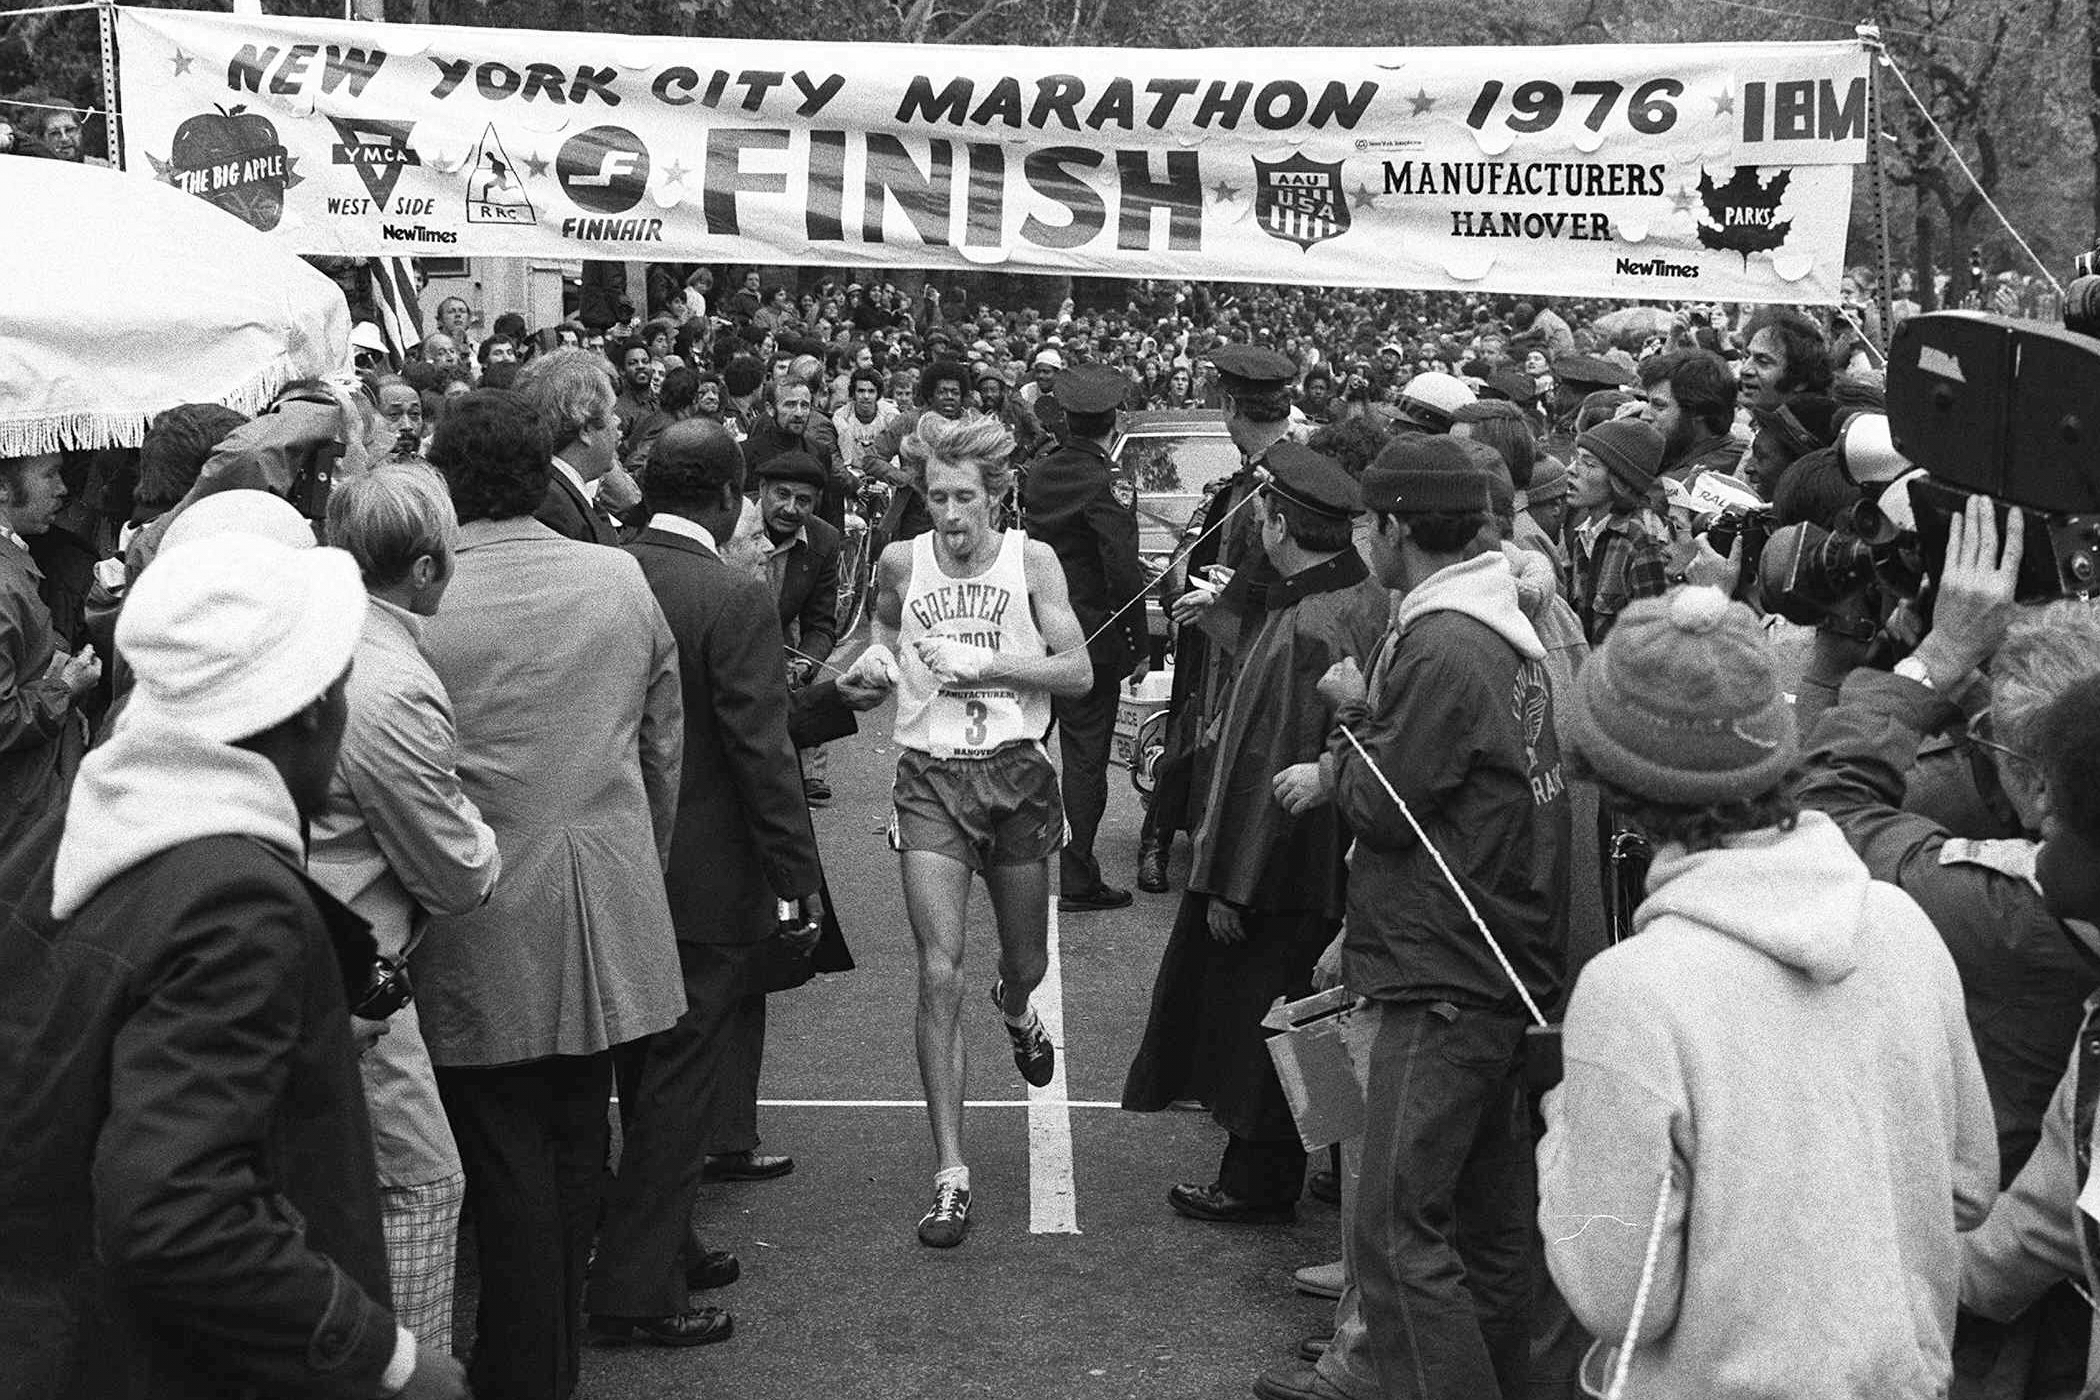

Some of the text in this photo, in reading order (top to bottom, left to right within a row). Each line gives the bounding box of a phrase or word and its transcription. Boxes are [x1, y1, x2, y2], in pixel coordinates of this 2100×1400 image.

[227, 44, 1685, 133] NEW YORK CITY MARATHON 1976
[1743, 76, 1867, 142] IBM
[344, 147, 408, 162] YMCA
[174, 155, 283, 194] THE BIG APPLE
[703, 127, 1202, 251] FINISH
[1278, 174, 1319, 186] AAU
[1382, 161, 1665, 196] MANUFACTURERS
[328, 197, 435, 215] WEST SIDE
[481, 205, 517, 219] RRC
[1278, 189, 1335, 222] USA
[1725, 207, 1771, 226] PARKS
[562, 217, 662, 241] FINNAIR
[1450, 212, 1614, 241] HANOVER
[910, 584, 1011, 629] GREATER
[965, 700, 987, 745] 3
[954, 748, 995, 756] HANOVE
